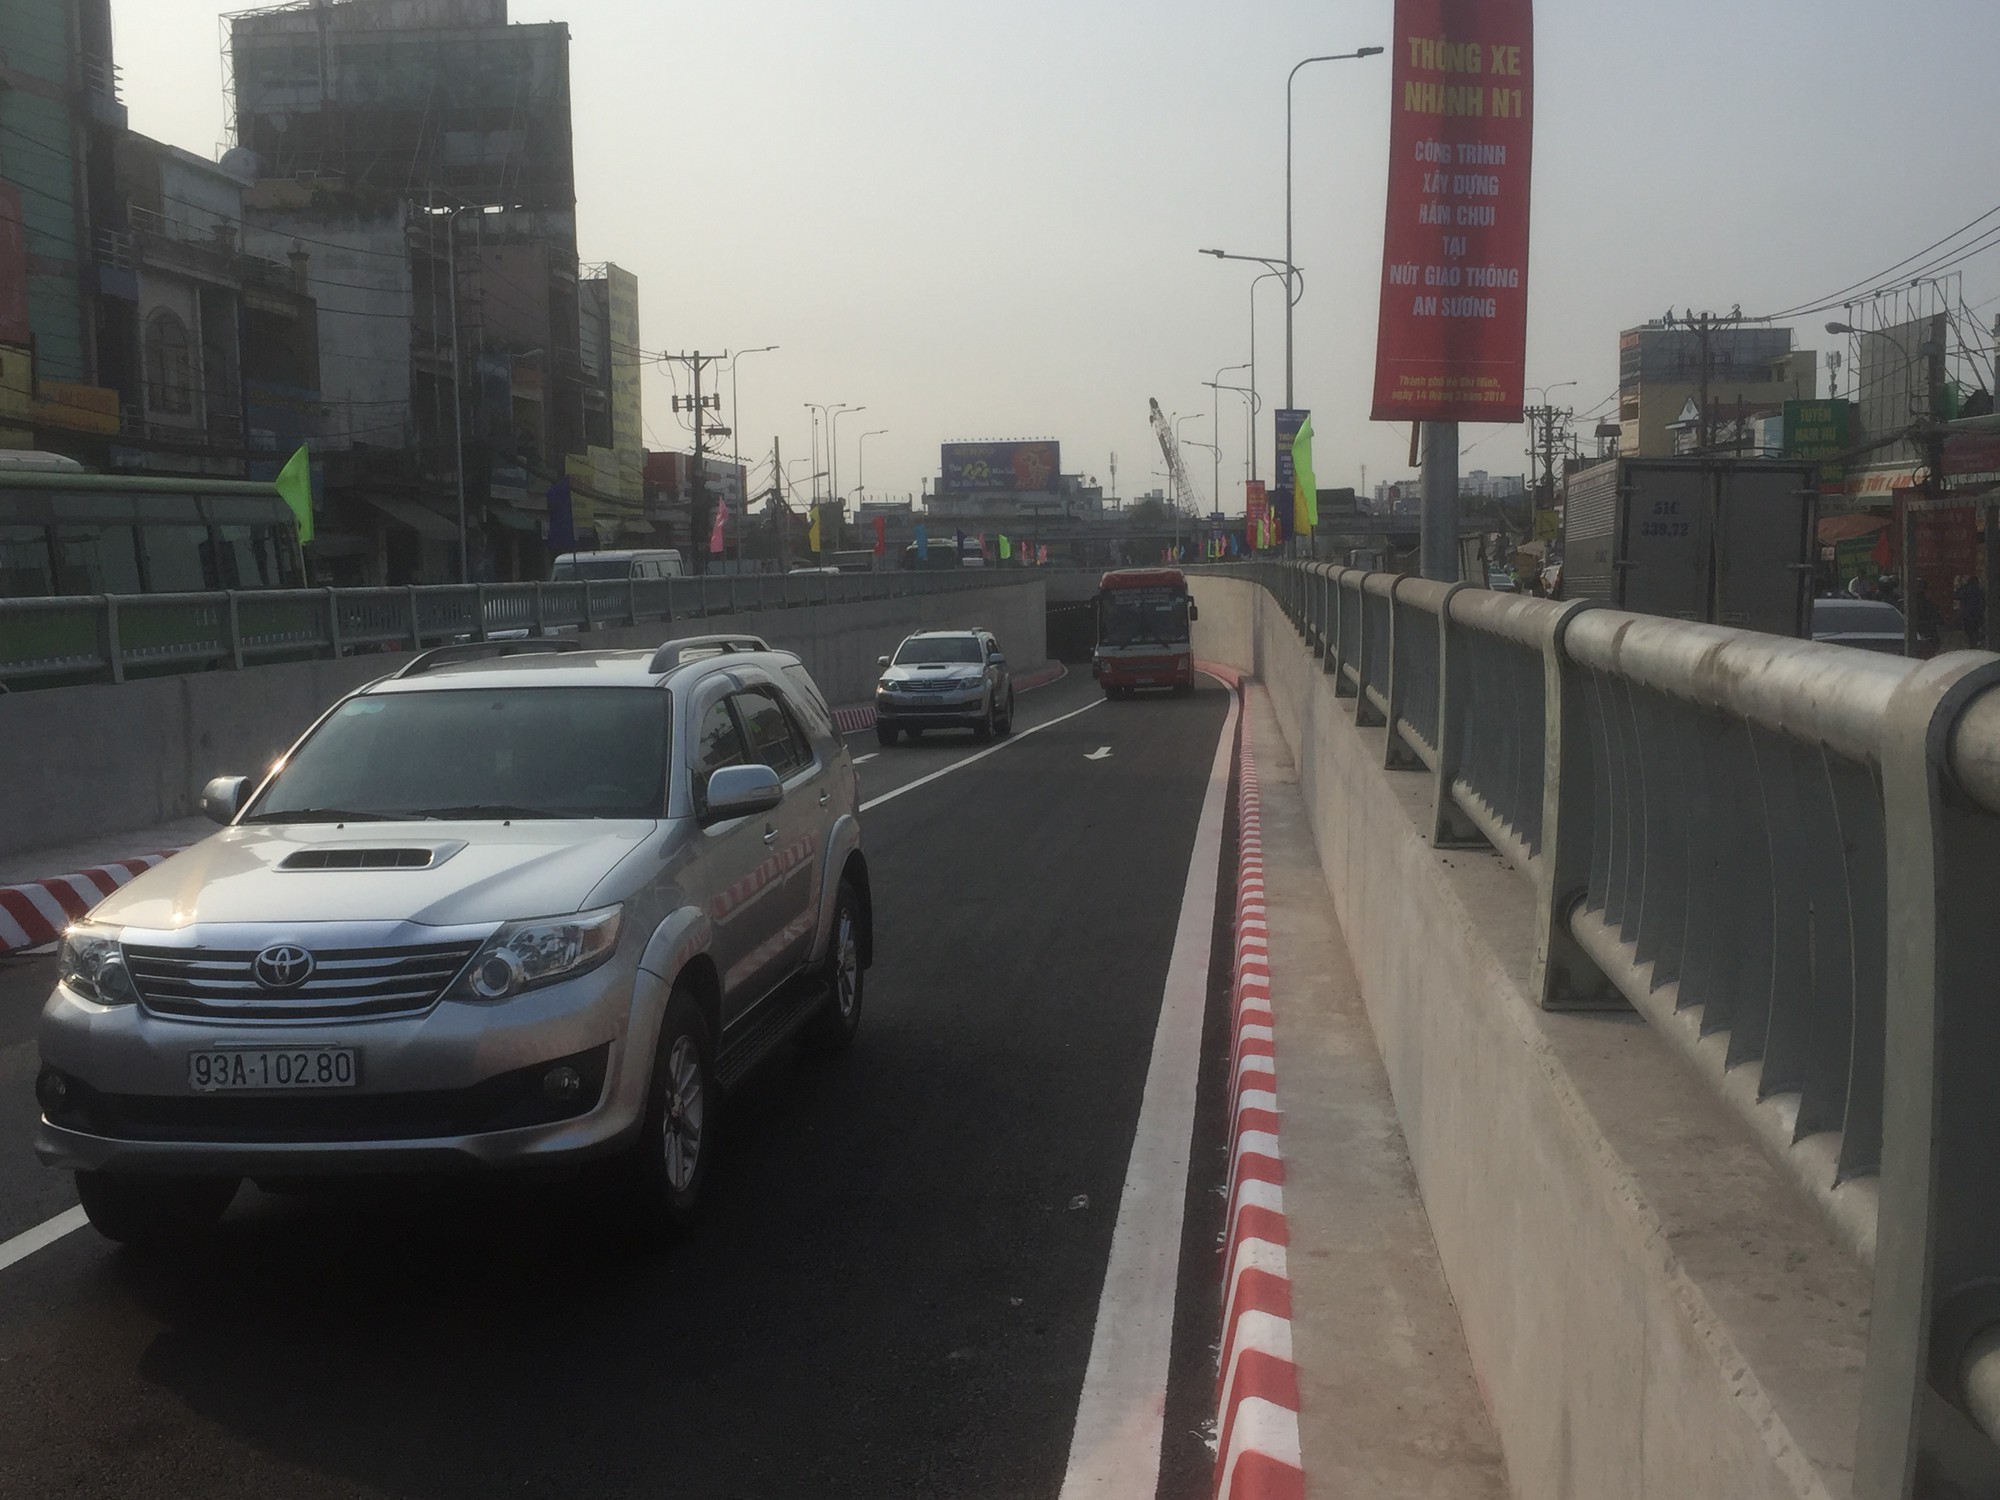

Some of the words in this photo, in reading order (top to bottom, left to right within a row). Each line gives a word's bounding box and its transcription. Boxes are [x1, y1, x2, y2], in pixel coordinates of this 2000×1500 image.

[1409, 34, 1481, 73] THÔNG
[1489, 45, 1521, 75] XE
[1404, 78, 1483, 117] NHÁNH
[1491, 87, 1522, 118] N1
[1415, 137, 1451, 164] CÔNG
[1457, 140, 1506, 165] TRÌNH
[1422, 169, 1448, 193] XÂY
[1453, 174, 1499, 199] DỰNG
[1419, 199, 1452, 225] HẦM
[1456, 205, 1496, 226] CHUI
[1442, 236, 1467, 260] TẠI
[1389, 261, 1420, 285] NÚT
[1424, 265, 1461, 287] GIAO
[1465, 263, 1519, 288] THÔNG
[1412, 296, 1437, 316] AN
[1441, 297, 1497, 318] SƯƠNG
[1653, 501, 1681, 515] 51C
[195, 1053, 351, 1085] 93A-102.80
